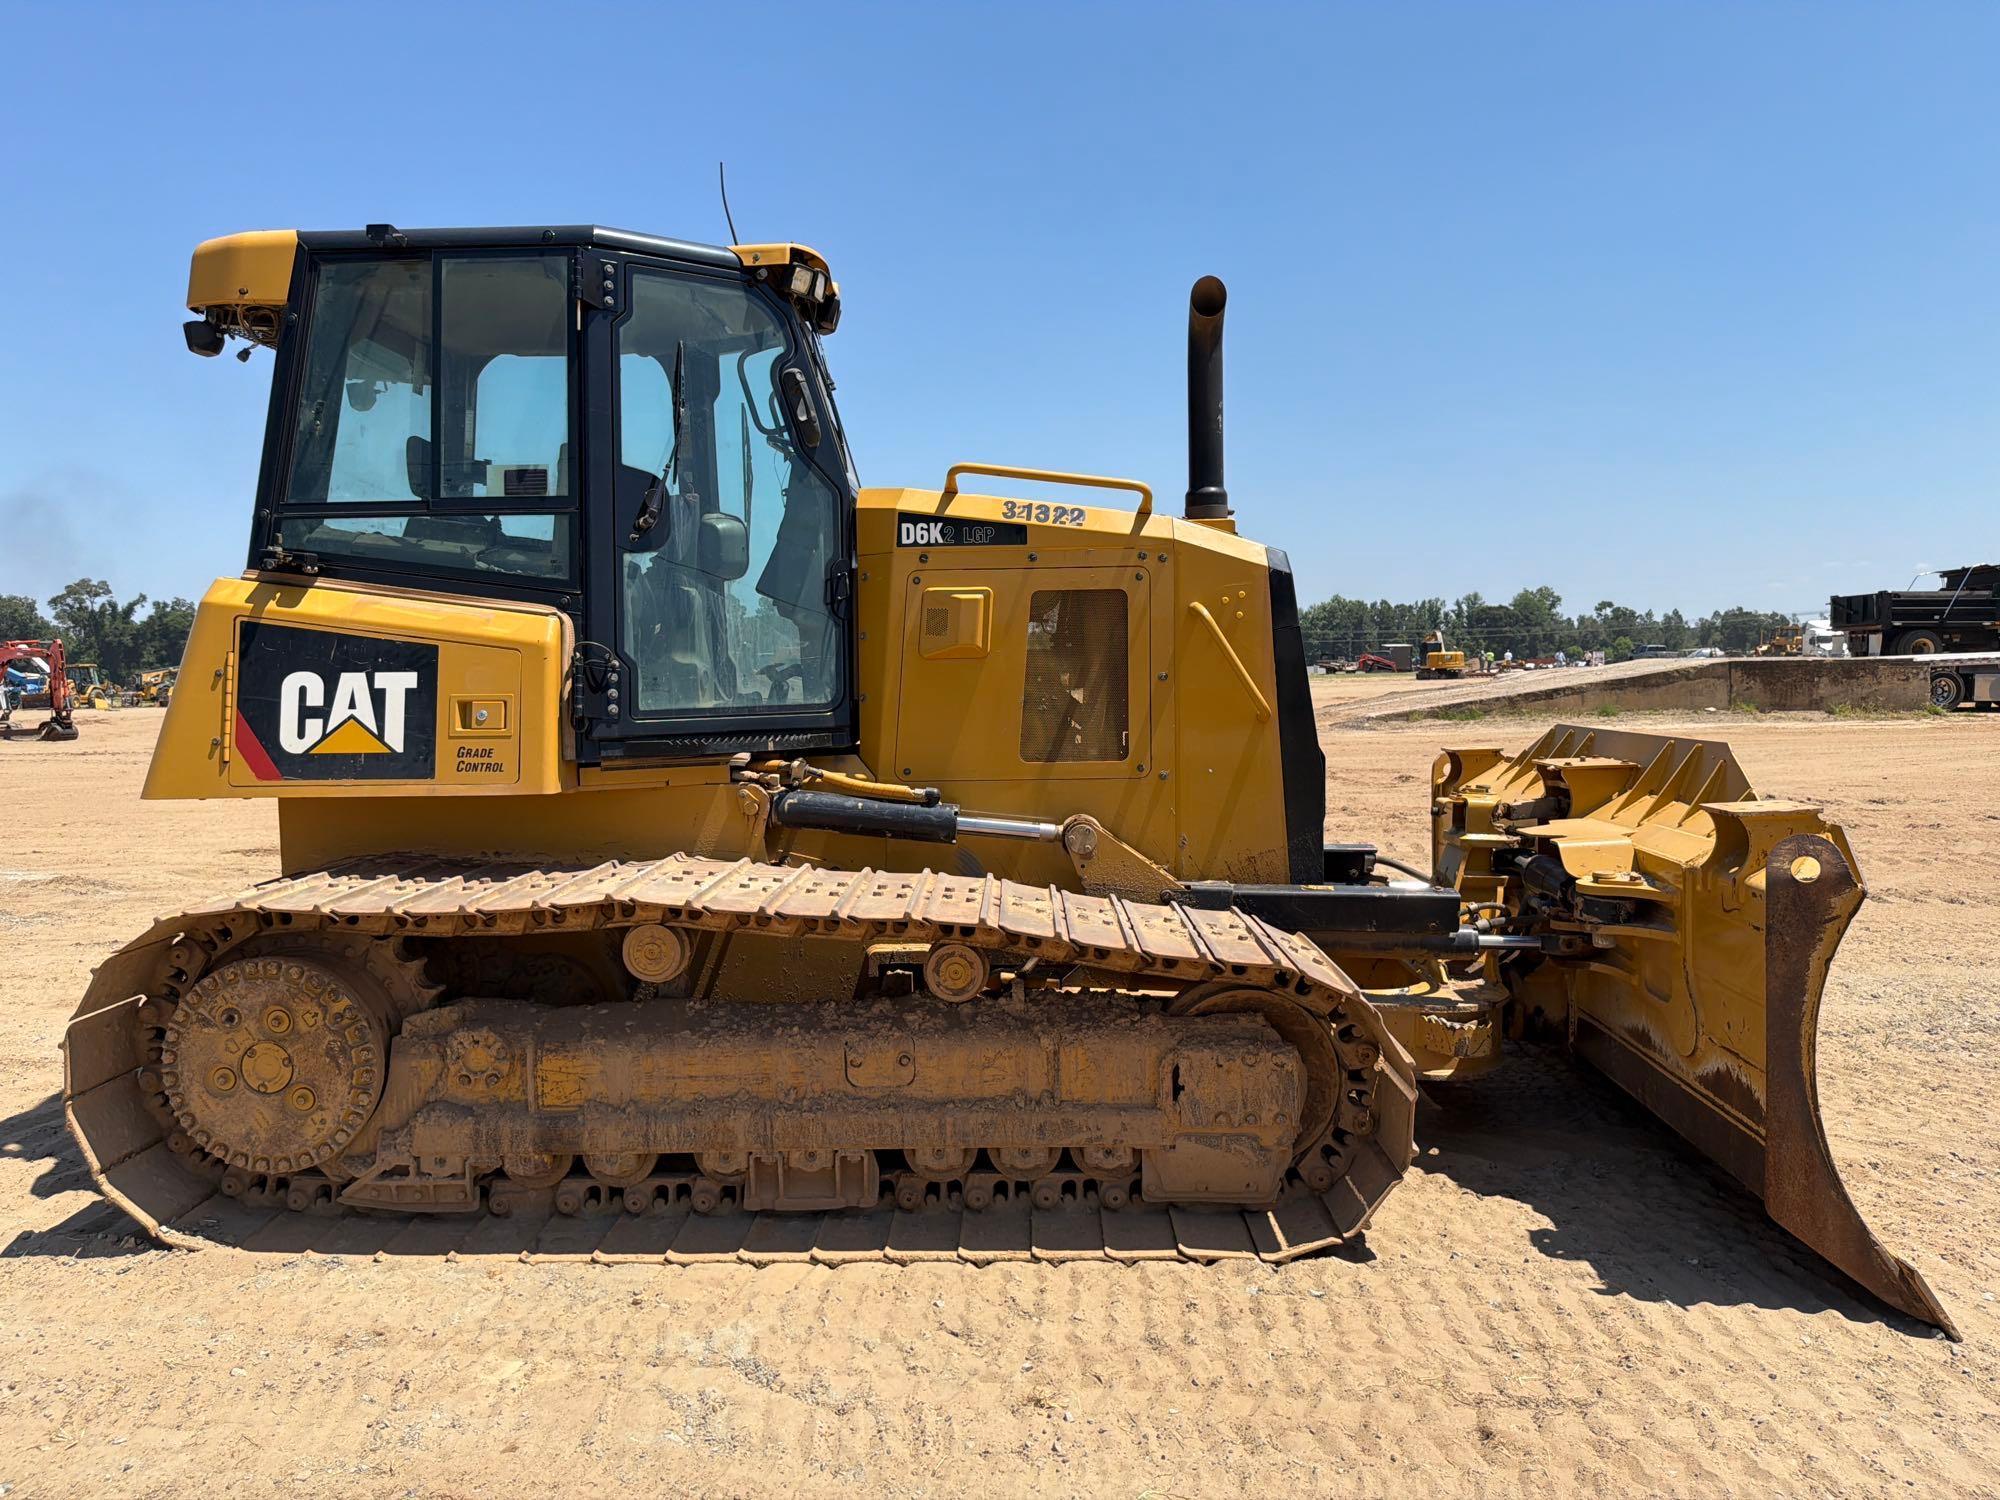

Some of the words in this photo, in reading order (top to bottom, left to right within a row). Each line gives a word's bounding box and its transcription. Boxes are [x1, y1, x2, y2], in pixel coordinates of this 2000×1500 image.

[963, 526, 995, 543] LGP
[279, 671, 418, 754] CAT
[456, 746, 495, 758] GRADE
[456, 760, 505, 773] CONTROL
